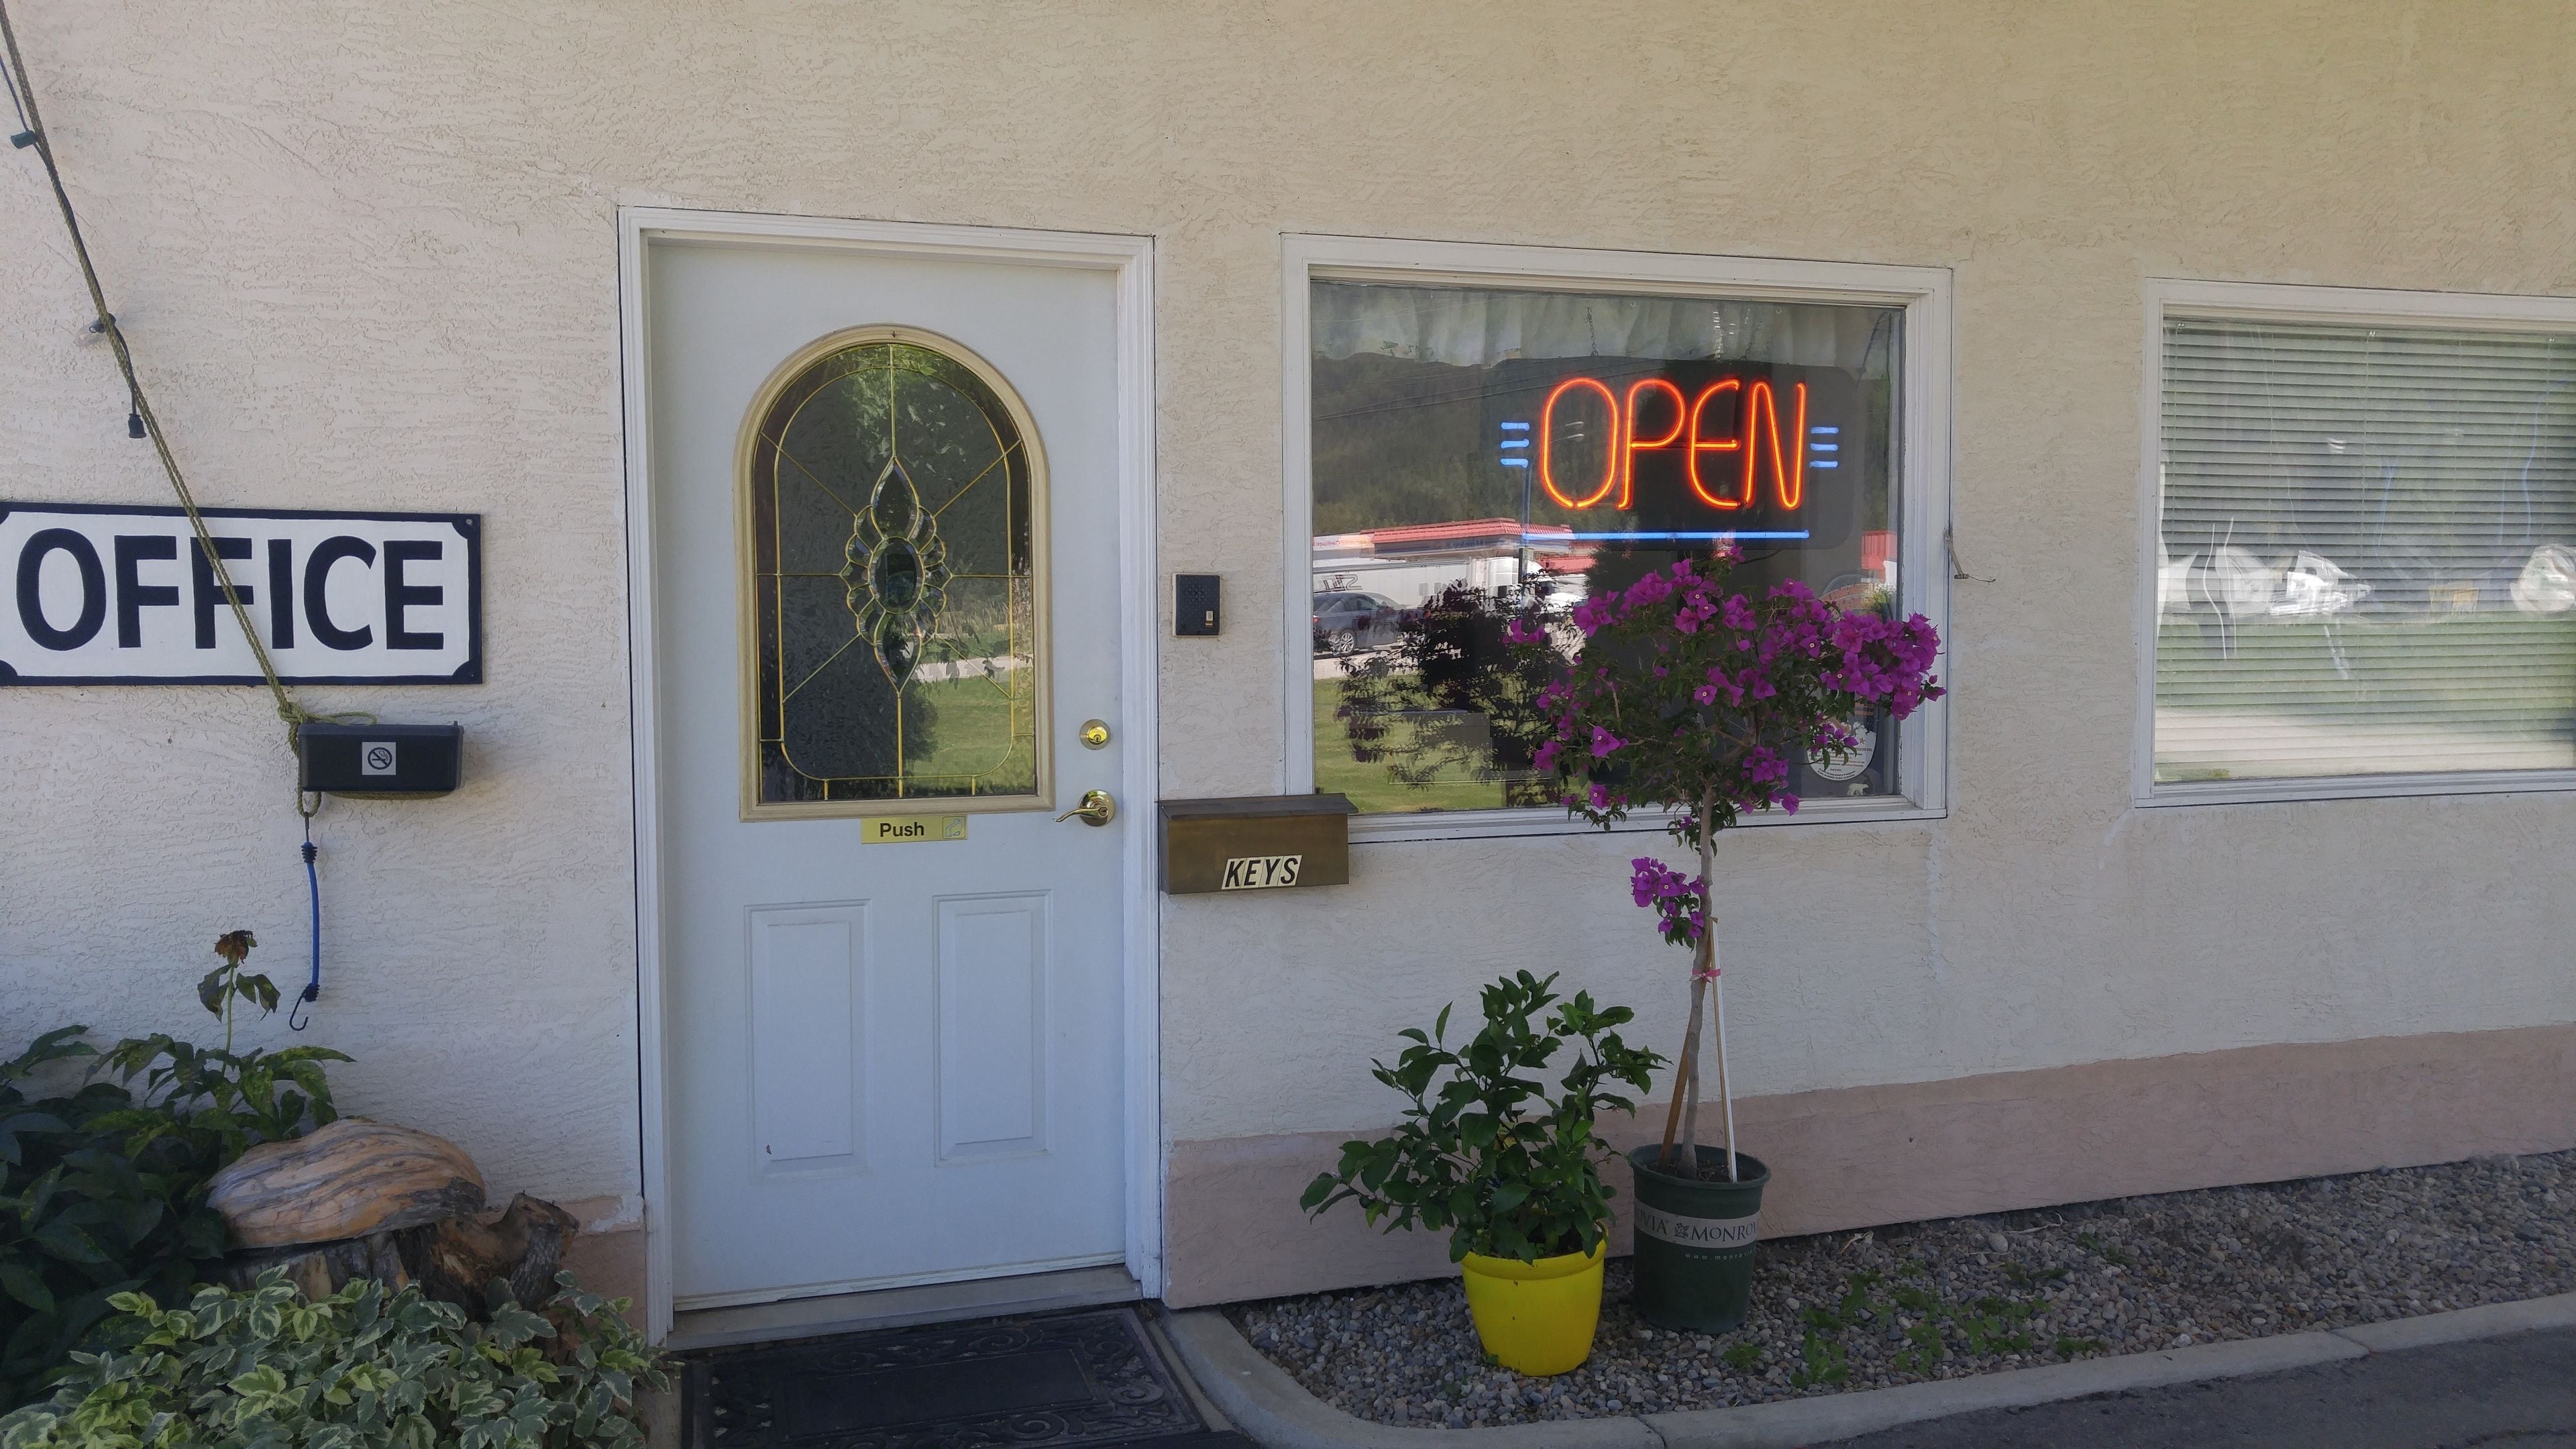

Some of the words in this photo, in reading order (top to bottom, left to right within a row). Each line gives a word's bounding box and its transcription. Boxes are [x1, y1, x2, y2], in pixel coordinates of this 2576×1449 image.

[1541, 376, 1807, 511] OPEN
[16, 527, 444, 651] OFFICE
[879, 822, 924, 837] Push
[1224, 857, 1299, 888] KEYS
